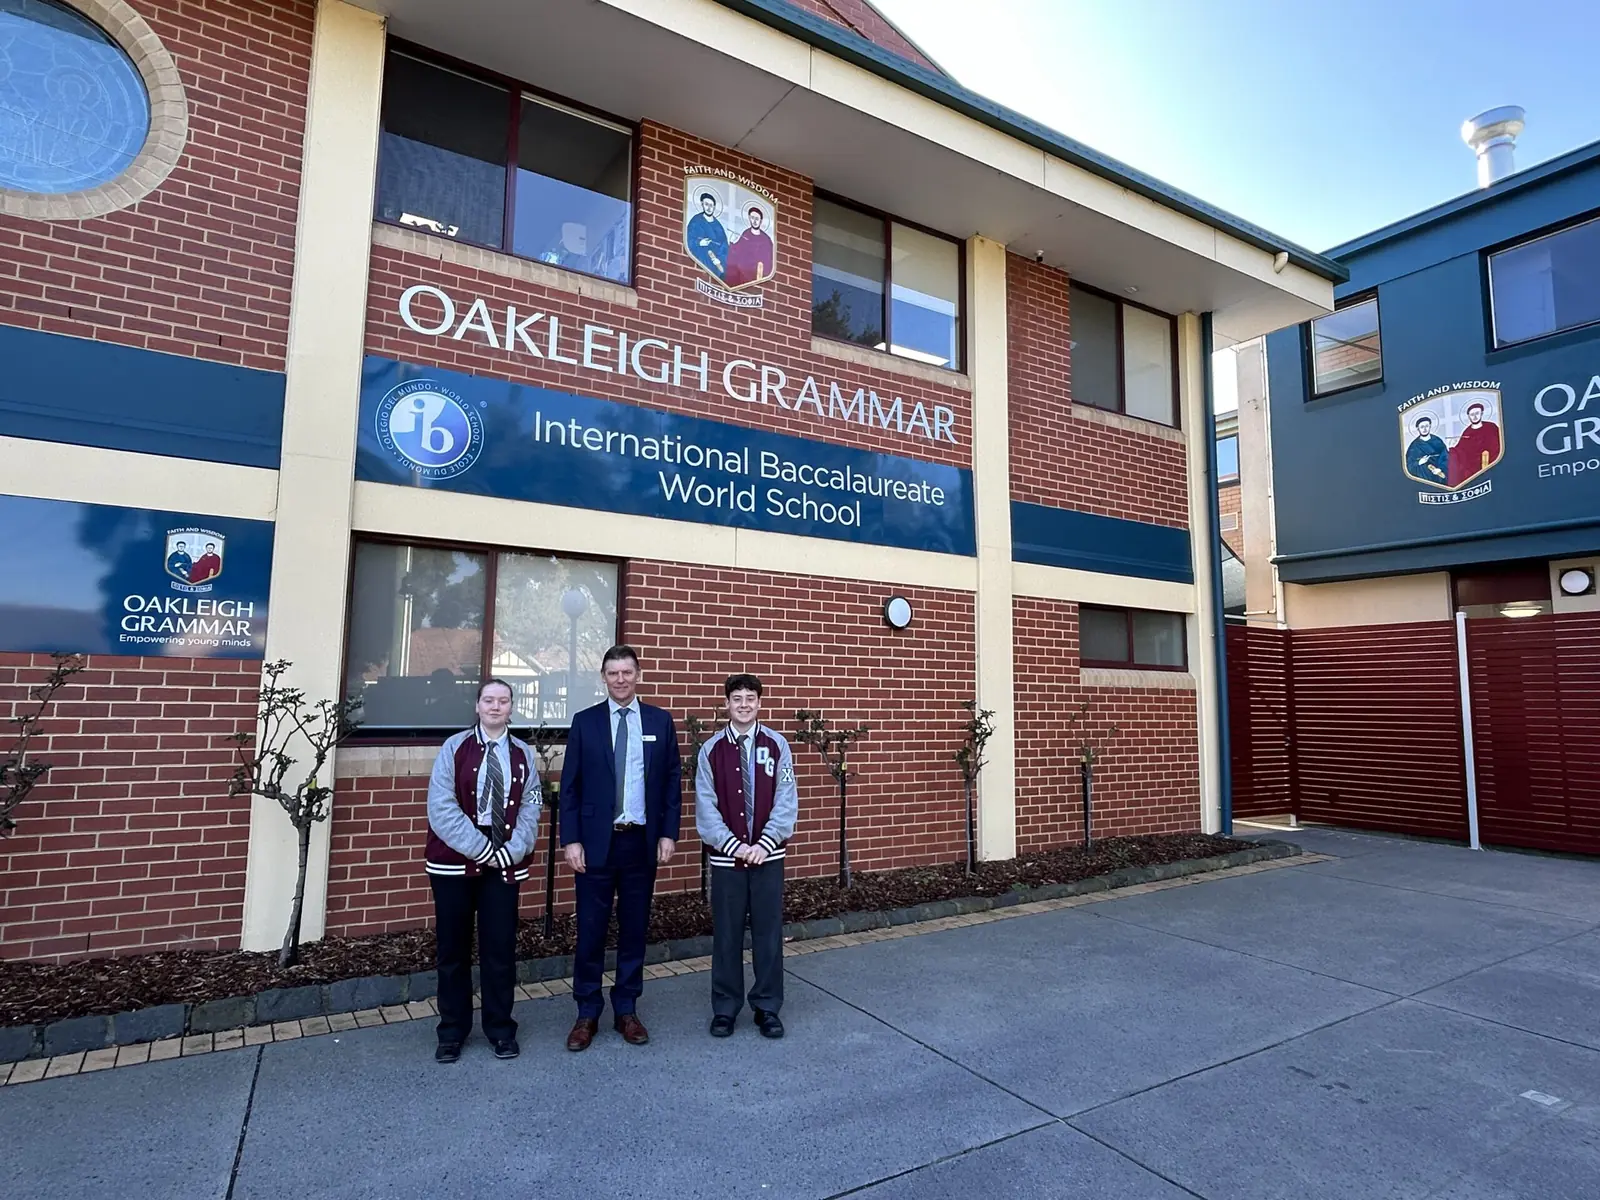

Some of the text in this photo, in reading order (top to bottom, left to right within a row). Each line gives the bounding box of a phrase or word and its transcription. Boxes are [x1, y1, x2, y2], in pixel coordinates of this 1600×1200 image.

[684, 165, 778, 204] FAITH AND WISDOM
[398, 284, 959, 444] OAKLEIGH GRAMMAR
[1397, 380, 1501, 412] FAITH AND WISDOM
[380, 383, 432, 450] COLEGIO DEL MUNDO
[441, 386, 481, 445] WORLD SCHOOL
[396, 454, 431, 476] MONDE
[434, 467, 448, 476] DU
[534, 411, 946, 506] International Baccalaureate
[659, 471, 862, 527] World School
[200, 528, 226, 540] WISDOM
[123, 594, 254, 618] OAKLEIGH
[119, 633, 252, 648] Empowering young minds
[121, 614, 252, 637] GRAMMAR
